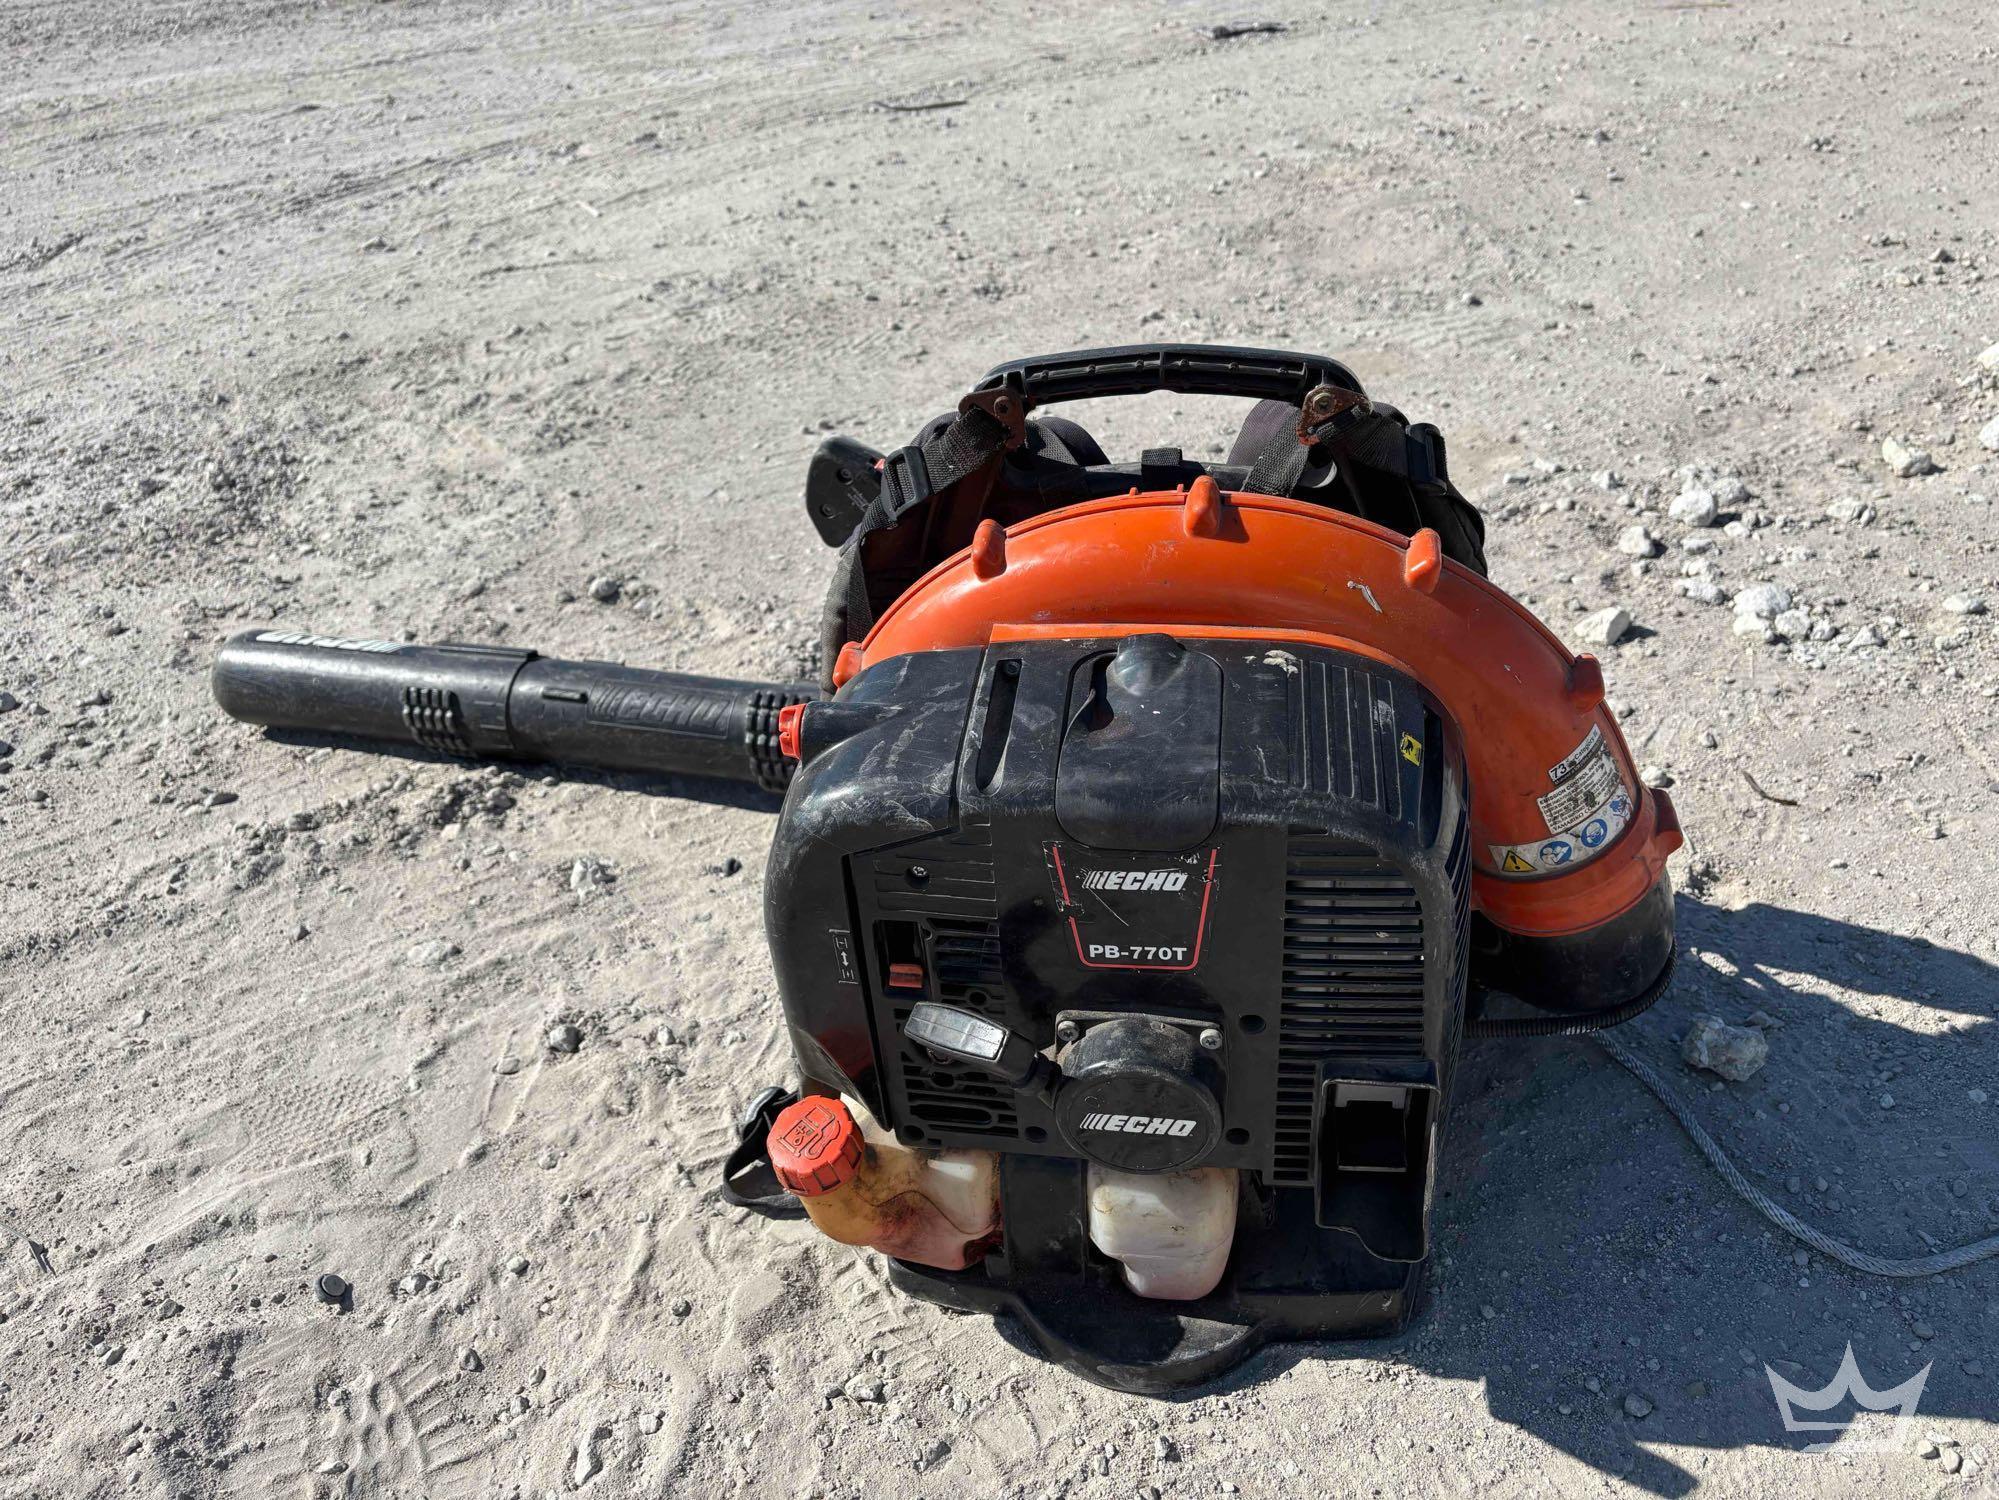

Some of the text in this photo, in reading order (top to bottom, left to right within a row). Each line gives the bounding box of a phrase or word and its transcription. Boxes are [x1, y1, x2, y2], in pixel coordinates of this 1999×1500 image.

[613, 687, 731, 730] ECHO
[1550, 763, 1567, 779] 73
[1574, 736, 1595, 760] Category
[1103, 870, 1188, 892] ECHO
[1089, 944, 1187, 961] PB-770T
[1103, 1114, 1197, 1137] ECHO
